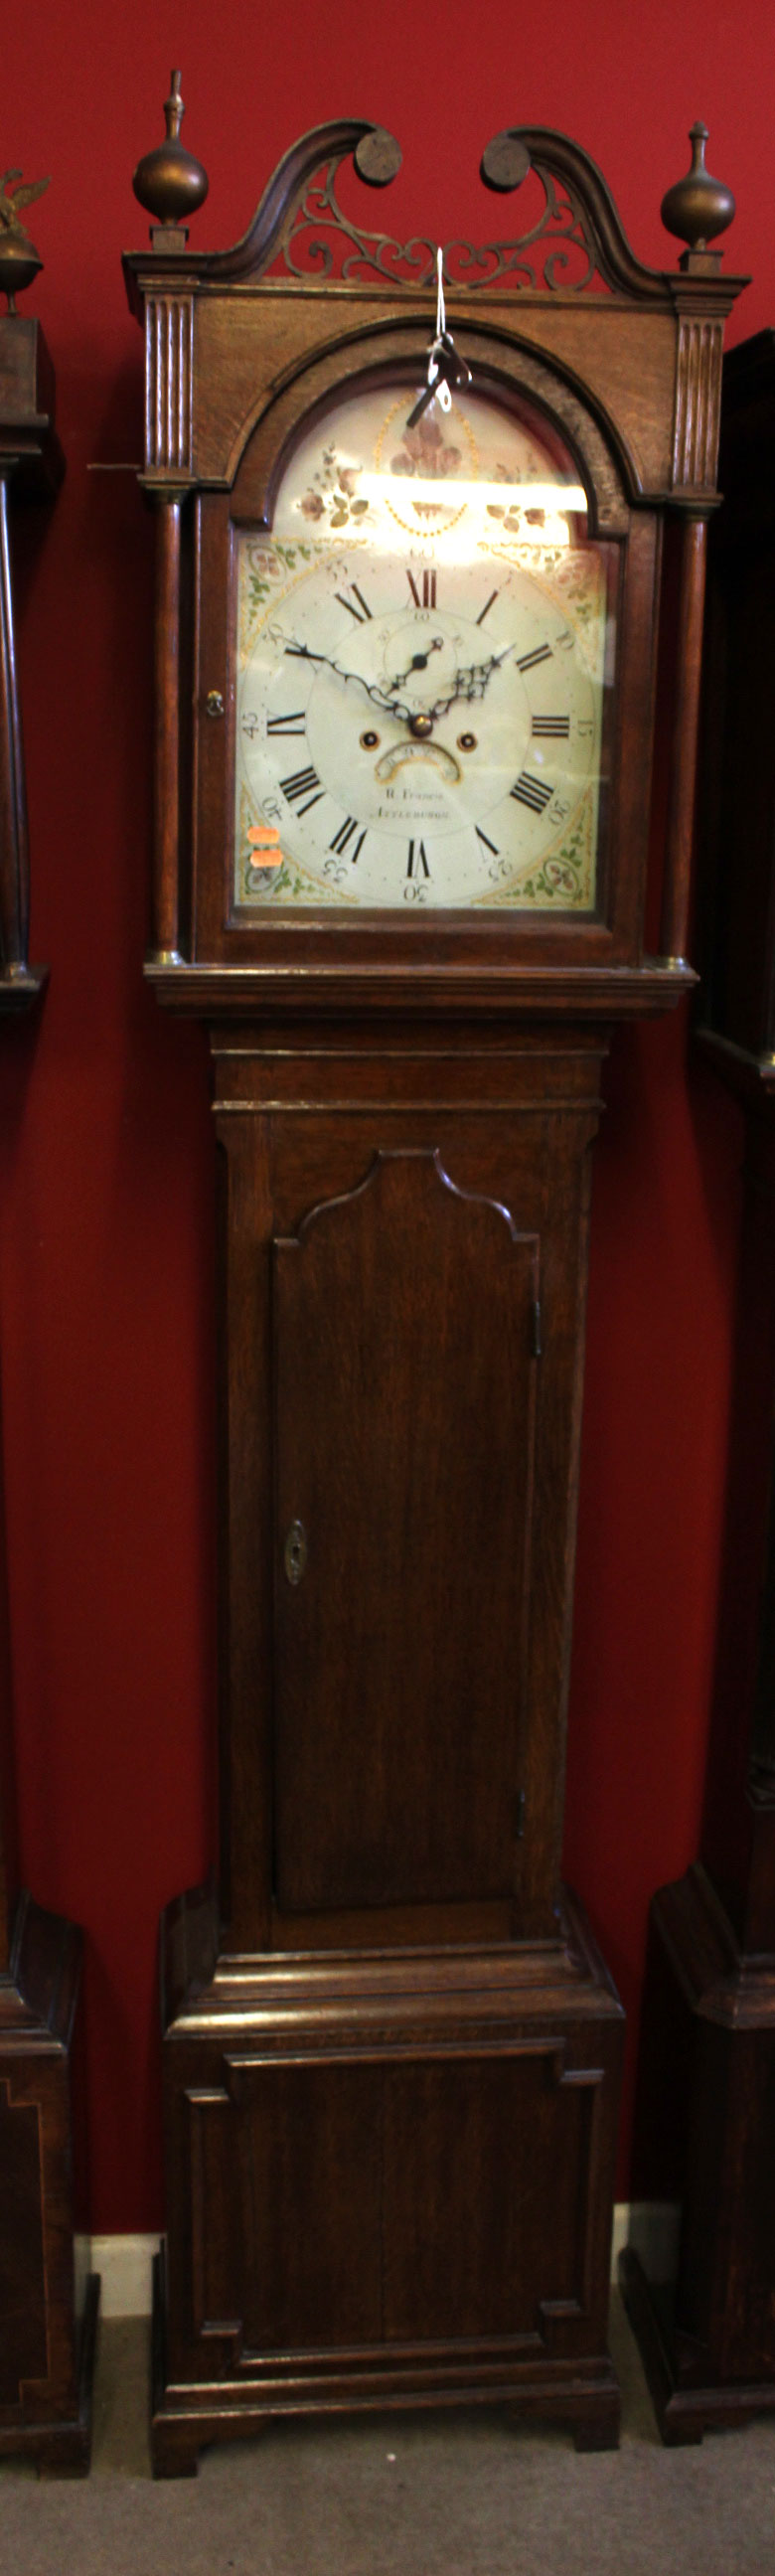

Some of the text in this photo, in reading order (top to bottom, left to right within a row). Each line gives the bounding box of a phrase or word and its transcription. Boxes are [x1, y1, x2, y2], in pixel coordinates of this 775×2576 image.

[407, 568, 436, 609] XII
[516, 642, 554, 674] II
[241, 712, 259, 739] 45
[265, 708, 306, 737] IX
[532, 714, 570, 739] III
[279, 765, 328, 819] VIII
[510, 770, 554, 815] IIII
[329, 816, 370, 865] VII
[405, 839, 431, 879] VI
[403, 884, 428, 903] 30
